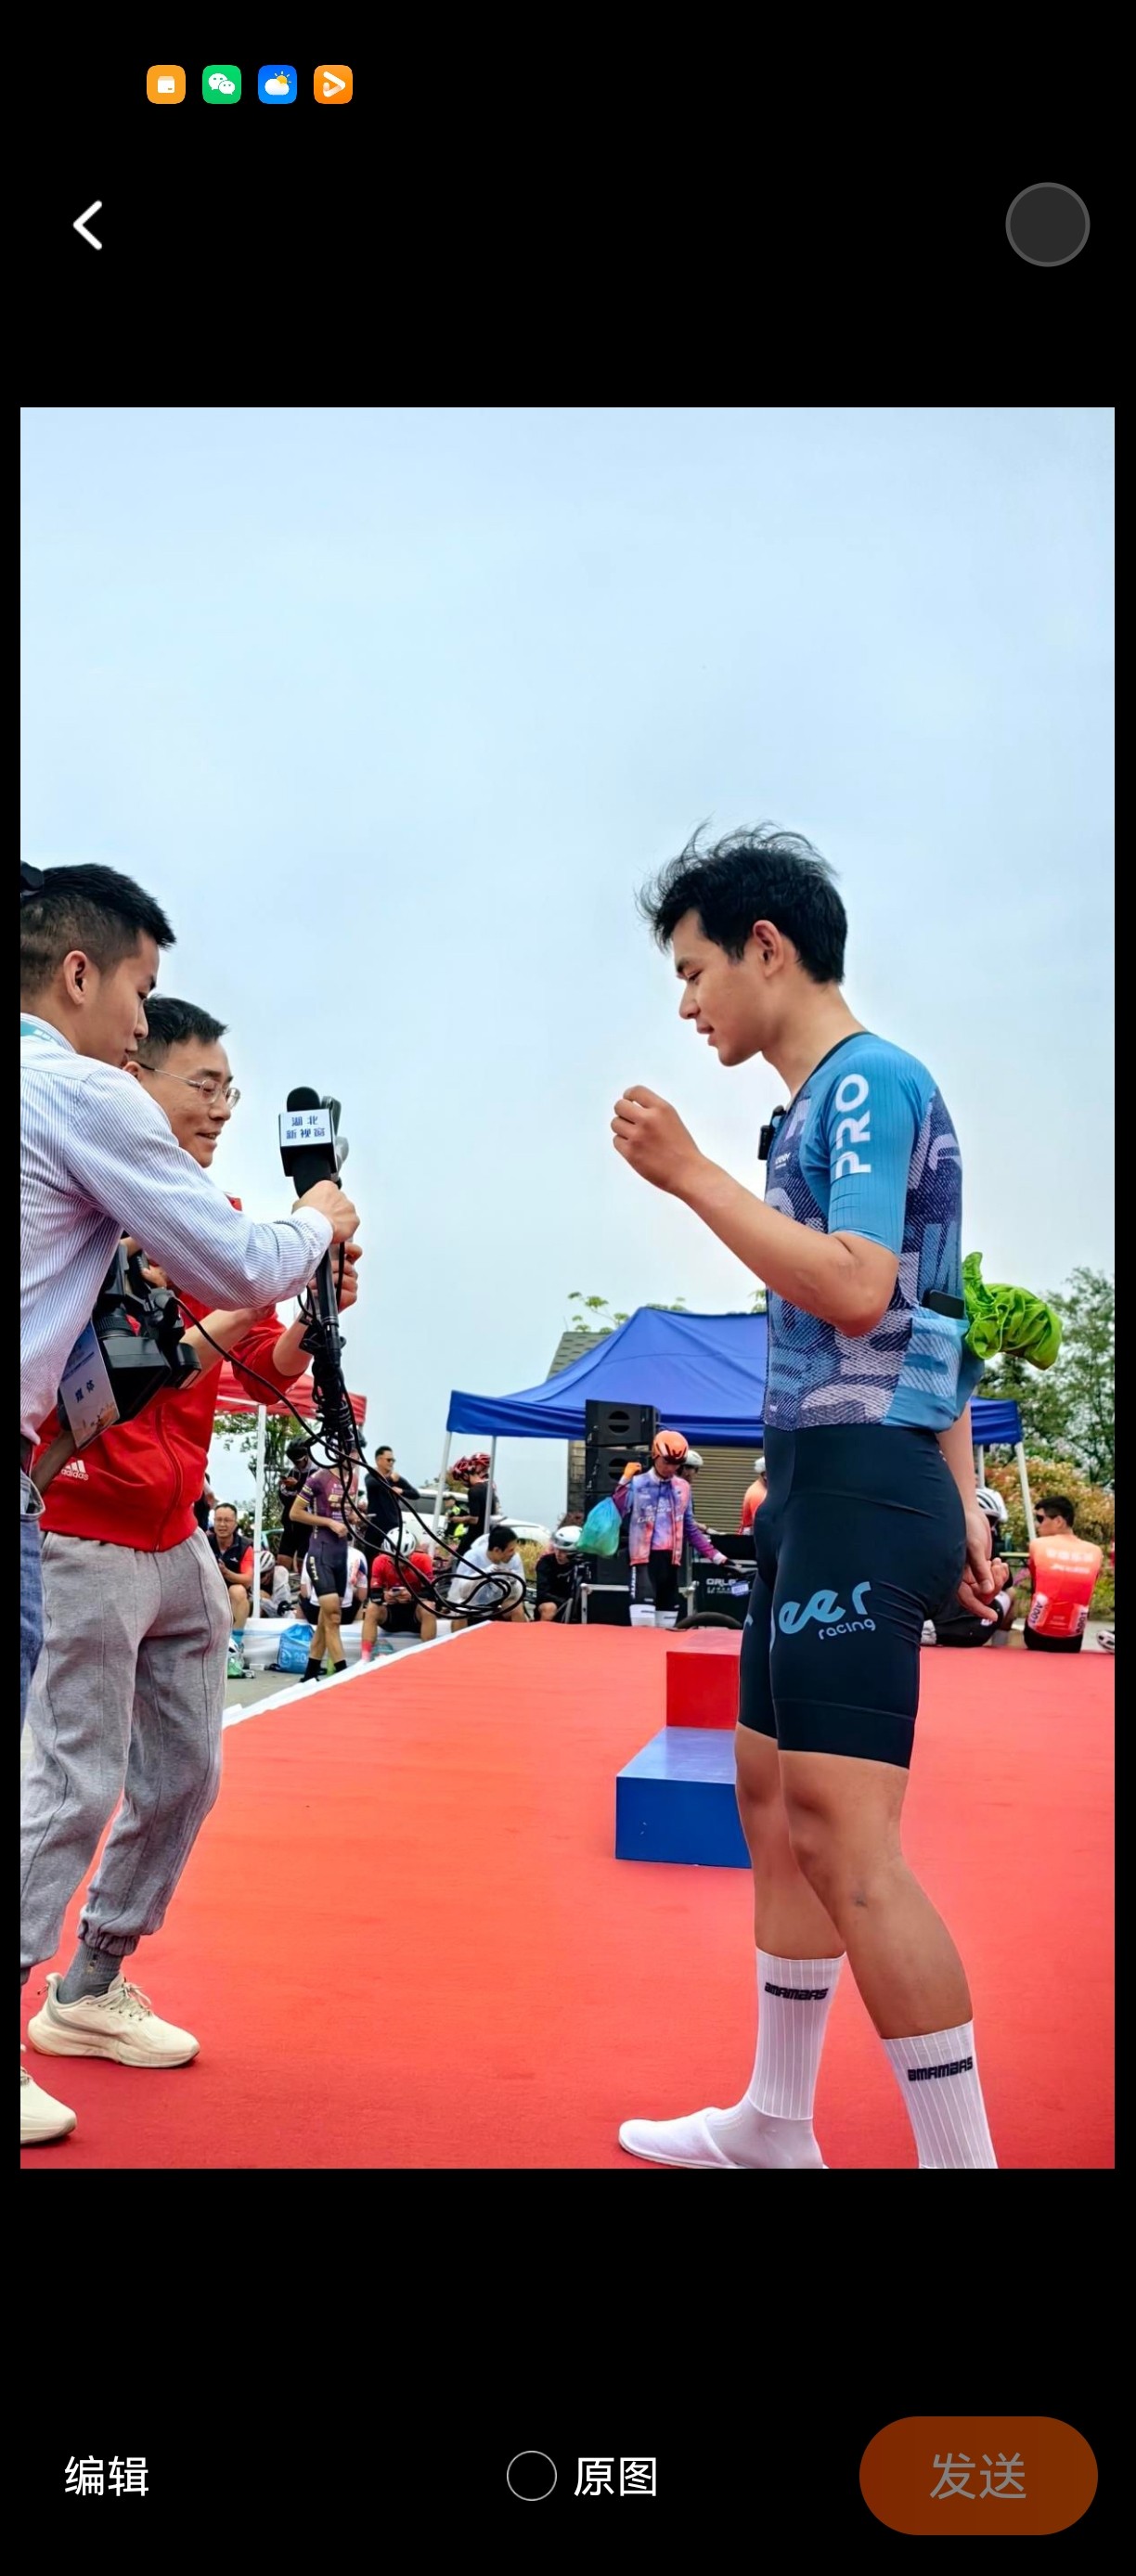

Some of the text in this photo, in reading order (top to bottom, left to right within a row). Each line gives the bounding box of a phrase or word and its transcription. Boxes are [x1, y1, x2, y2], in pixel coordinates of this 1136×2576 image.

[835, 1074, 871, 1179] PRO
[60, 1468, 89, 1481] adidas
[818, 1618, 876, 1640] racing
